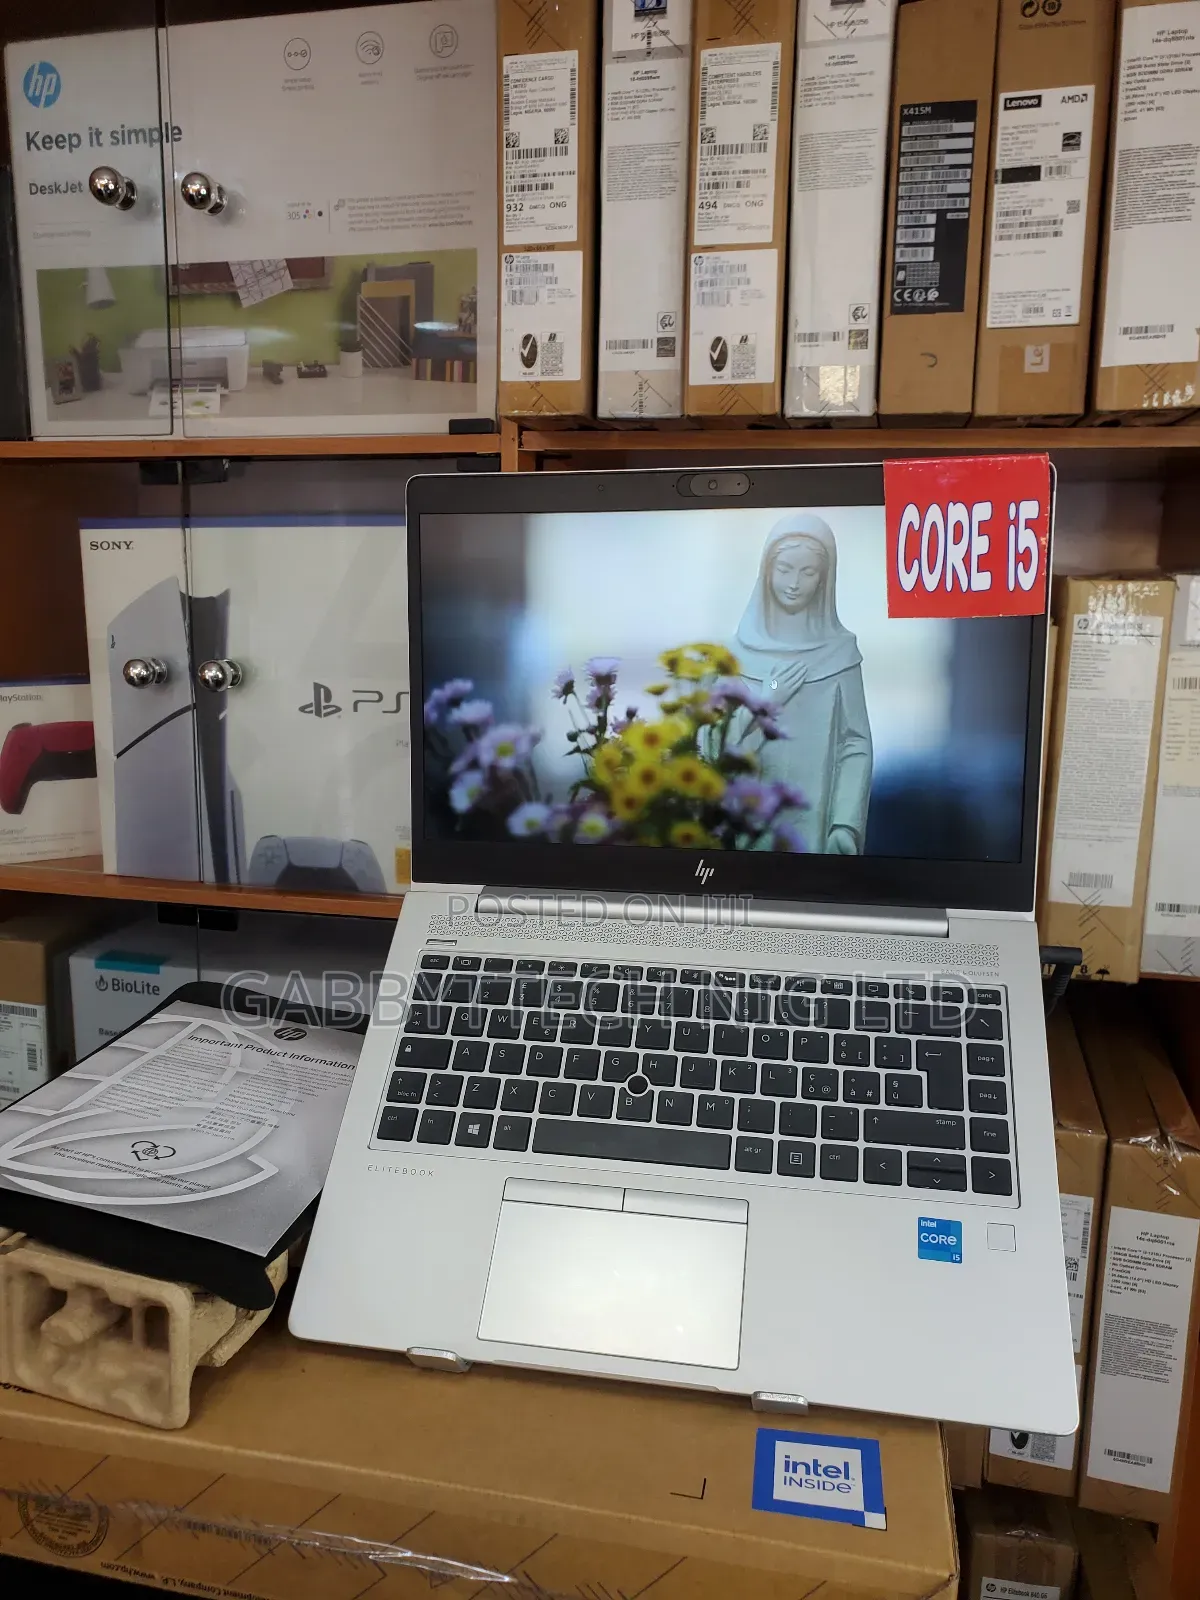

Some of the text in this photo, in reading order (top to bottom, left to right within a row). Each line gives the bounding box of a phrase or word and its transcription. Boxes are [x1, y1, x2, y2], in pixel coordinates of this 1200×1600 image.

[23, 61, 62, 109] hp
[1006, 95, 1080, 108] Lenovo AMD
[903, 106, 932, 116] X415M
[26, 122, 183, 153] Keep it simple
[29, 181, 84, 195] DeskJet
[506, 203, 524, 212] 932
[698, 200, 764, 210] 494 ONG
[287, 211, 301, 221] 305
[89, 541, 134, 551] SONY
[896, 499, 1041, 594] CORE i5
[111, 978, 160, 996] BioLite
[666, 1002, 672, 1010] 7
[461, 1013, 469, 1021] Q
[497, 1015, 509, 1023] W
[532, 1017, 540, 1025] E
[569, 1020, 576, 1028] R
[645, 1024, 653, 1033] Y
[98, 1027, 122, 1037] Base
[682, 1027, 690, 1036] U
[801, 1038, 808, 1046] P
[188, 1035, 356, 1070] Important Product Information
[462, 1047, 470, 1056] A
[499, 1050, 506, 1058] S
[535, 1052, 544, 1061] D
[573, 1054, 580, 1063] F
[611, 1057, 620, 1066] G
[650, 1060, 658, 1069] H
[688, 1063, 695, 1072] J
[728, 1068, 737, 1076] K
[769, 1071, 776, 1079] L
[472, 1083, 479, 1092] Z
[510, 1086, 518, 1095] X
[548, 1089, 556, 1098] C
[587, 1092, 596, 1101] V
[626, 1097, 633, 1106] B
[665, 1098, 674, 1107] N
[706, 1102, 715, 1111] M
[936, 1119, 957, 1127] stamp
[367, 1164, 435, 1177] ELITEBOOK
[161, 1178, 182, 1188] plastic
[920, 1219, 937, 1228] intel
[784, 1455, 850, 1480] intel
[101, 1561, 156, 1581] www.hp.com
